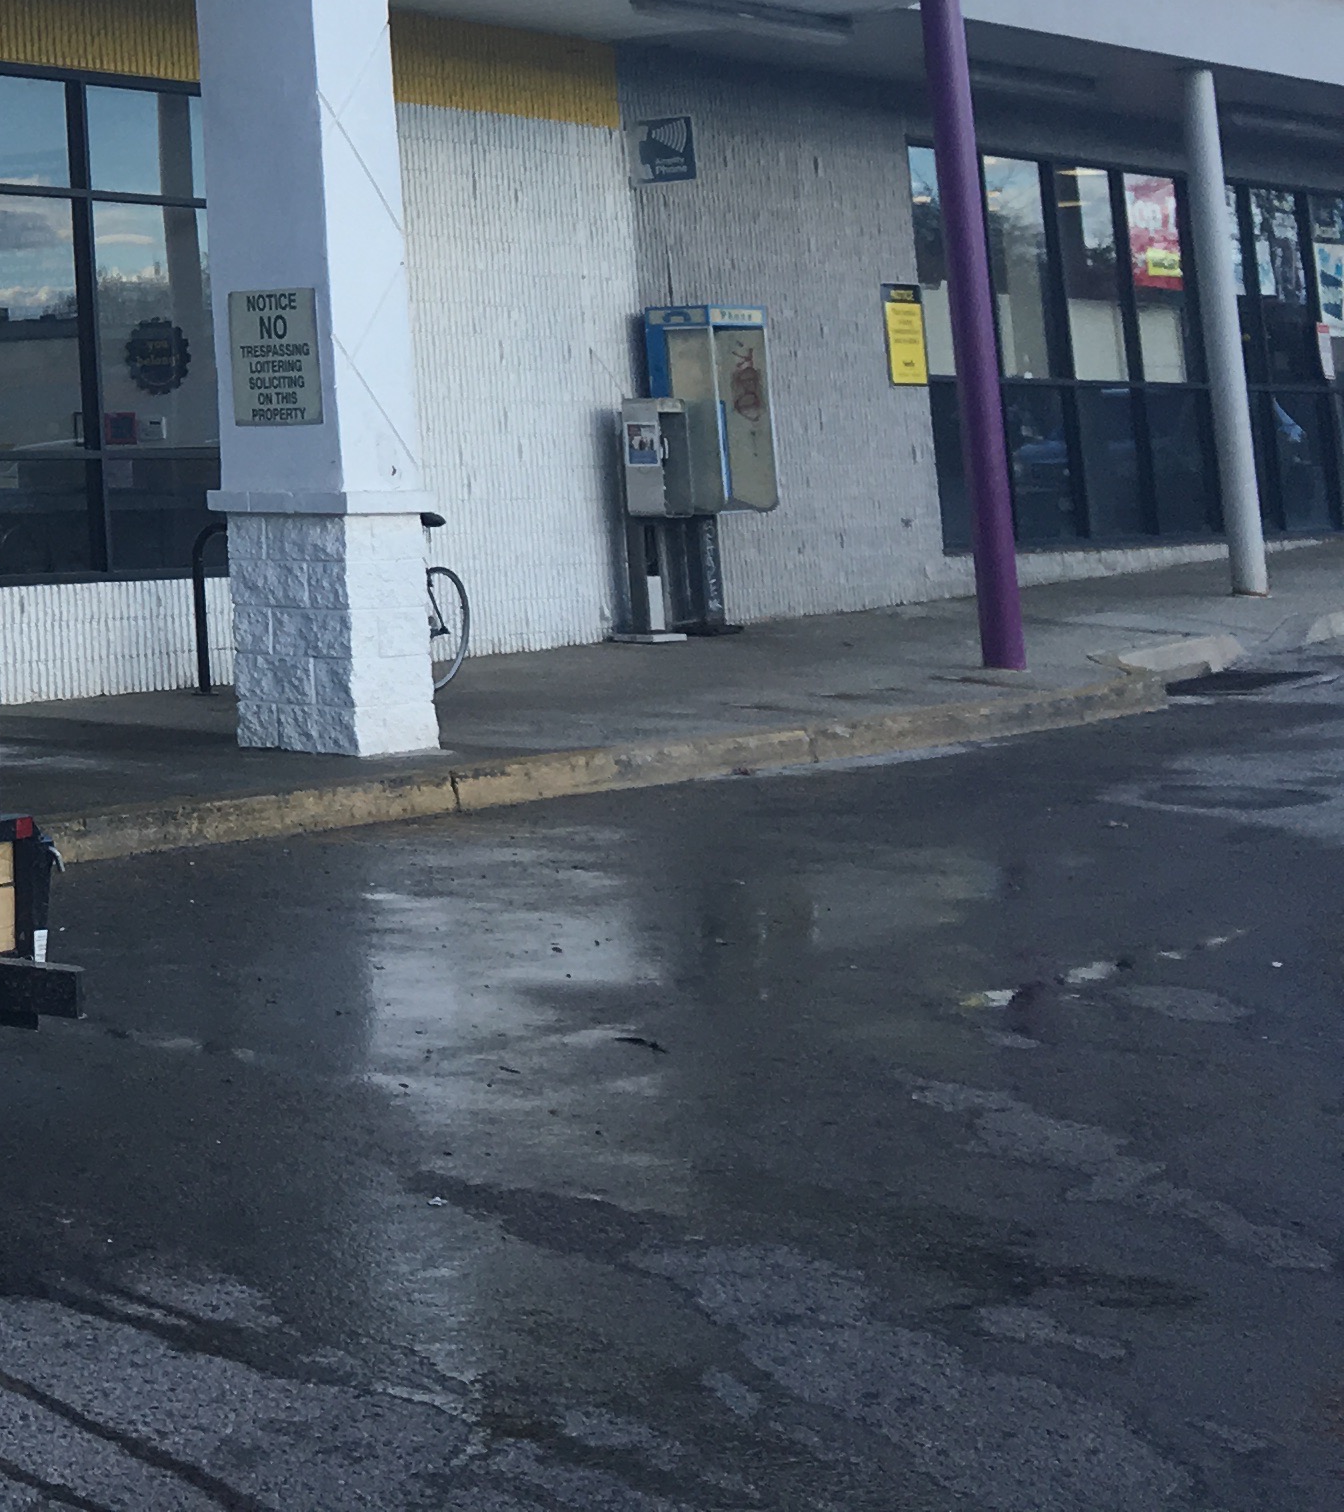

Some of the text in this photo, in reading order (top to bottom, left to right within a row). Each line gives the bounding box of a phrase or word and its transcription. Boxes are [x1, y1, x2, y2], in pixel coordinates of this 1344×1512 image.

[246, 292, 297, 312] NOTICE
[258, 314, 288, 340] NO
[240, 342, 310, 359] TRESPASSING
[249, 359, 303, 374] LOITERING
[248, 375, 305, 390] SOLICITING
[257, 391, 298, 405] ON THIS
[251, 407, 306, 422] PROPERTY
